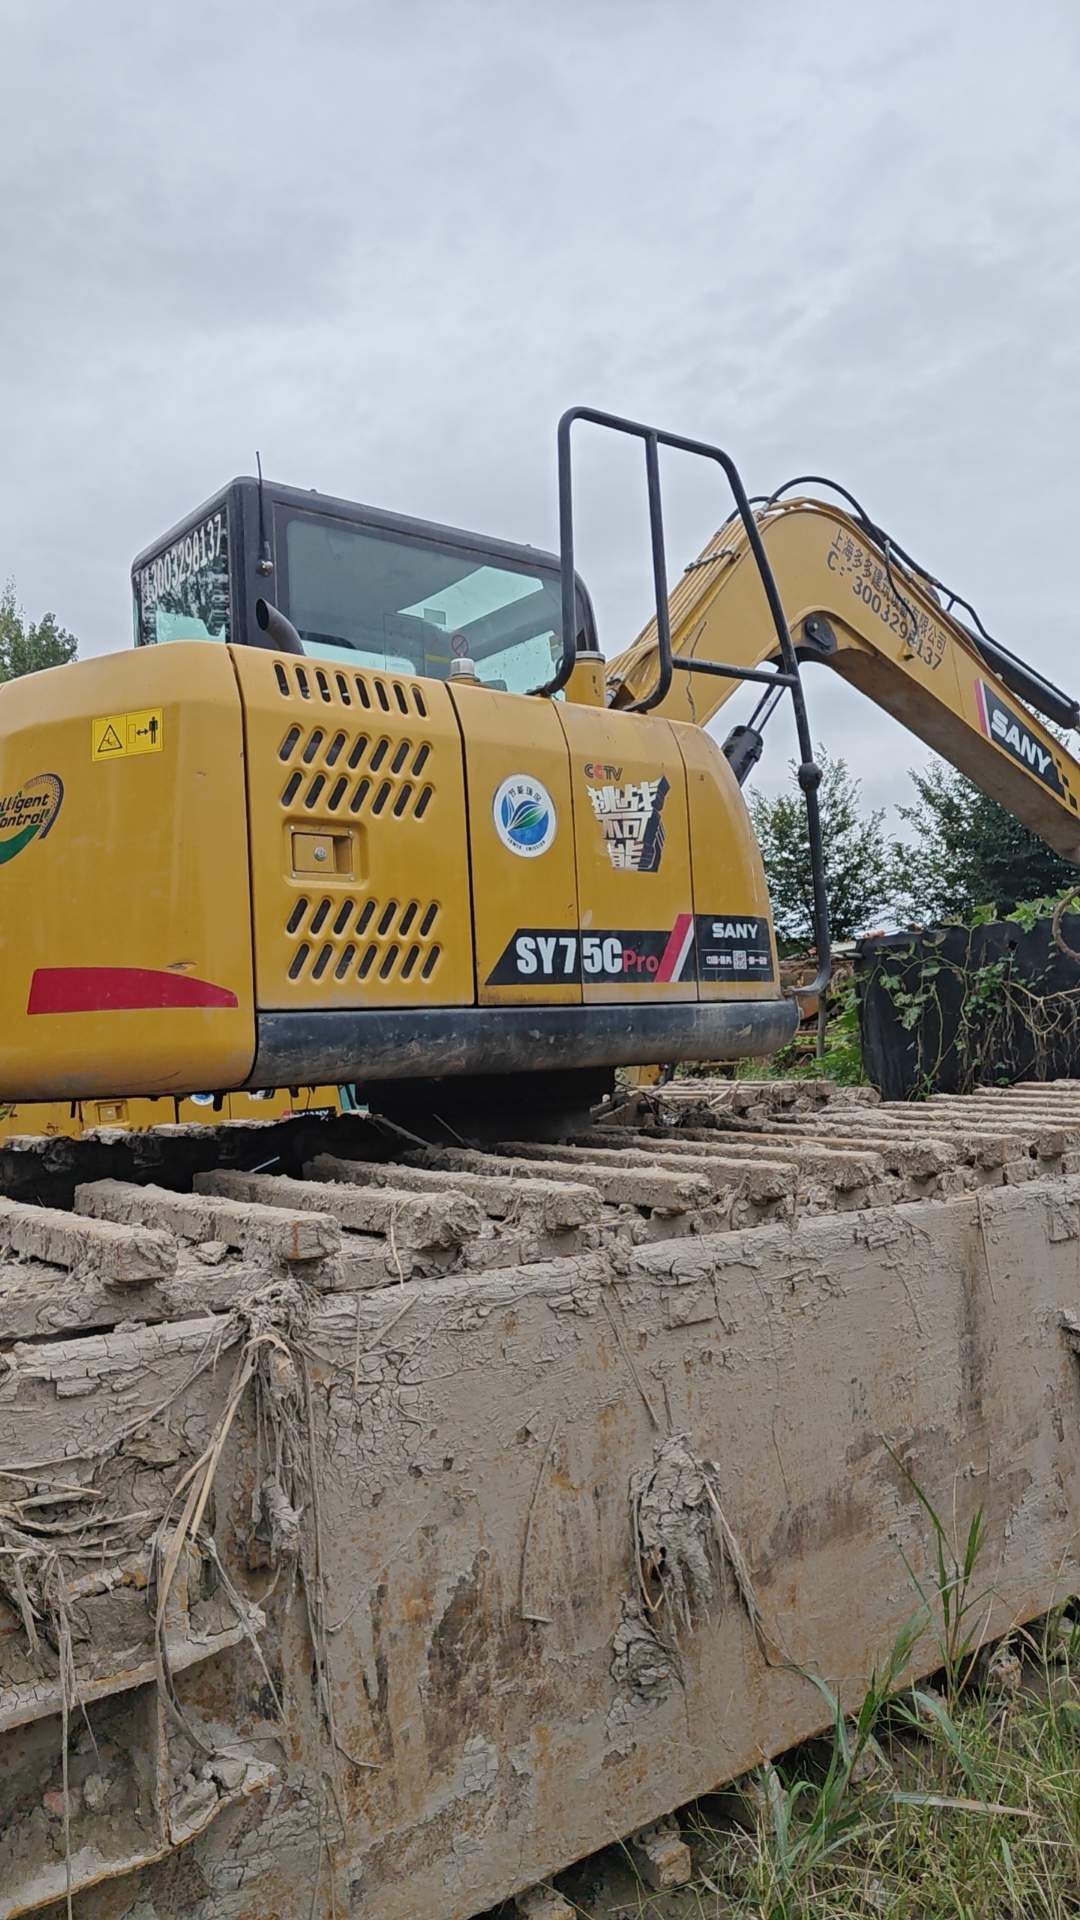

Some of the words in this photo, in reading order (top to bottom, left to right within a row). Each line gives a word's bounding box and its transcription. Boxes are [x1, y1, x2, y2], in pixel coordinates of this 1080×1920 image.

[990, 709, 1052, 774] SANY
[584, 762, 623, 781] CCTV
[0, 790, 50, 814] lligent
[586, 776, 661, 813] 挑战
[711, 922, 758, 940] SANY
